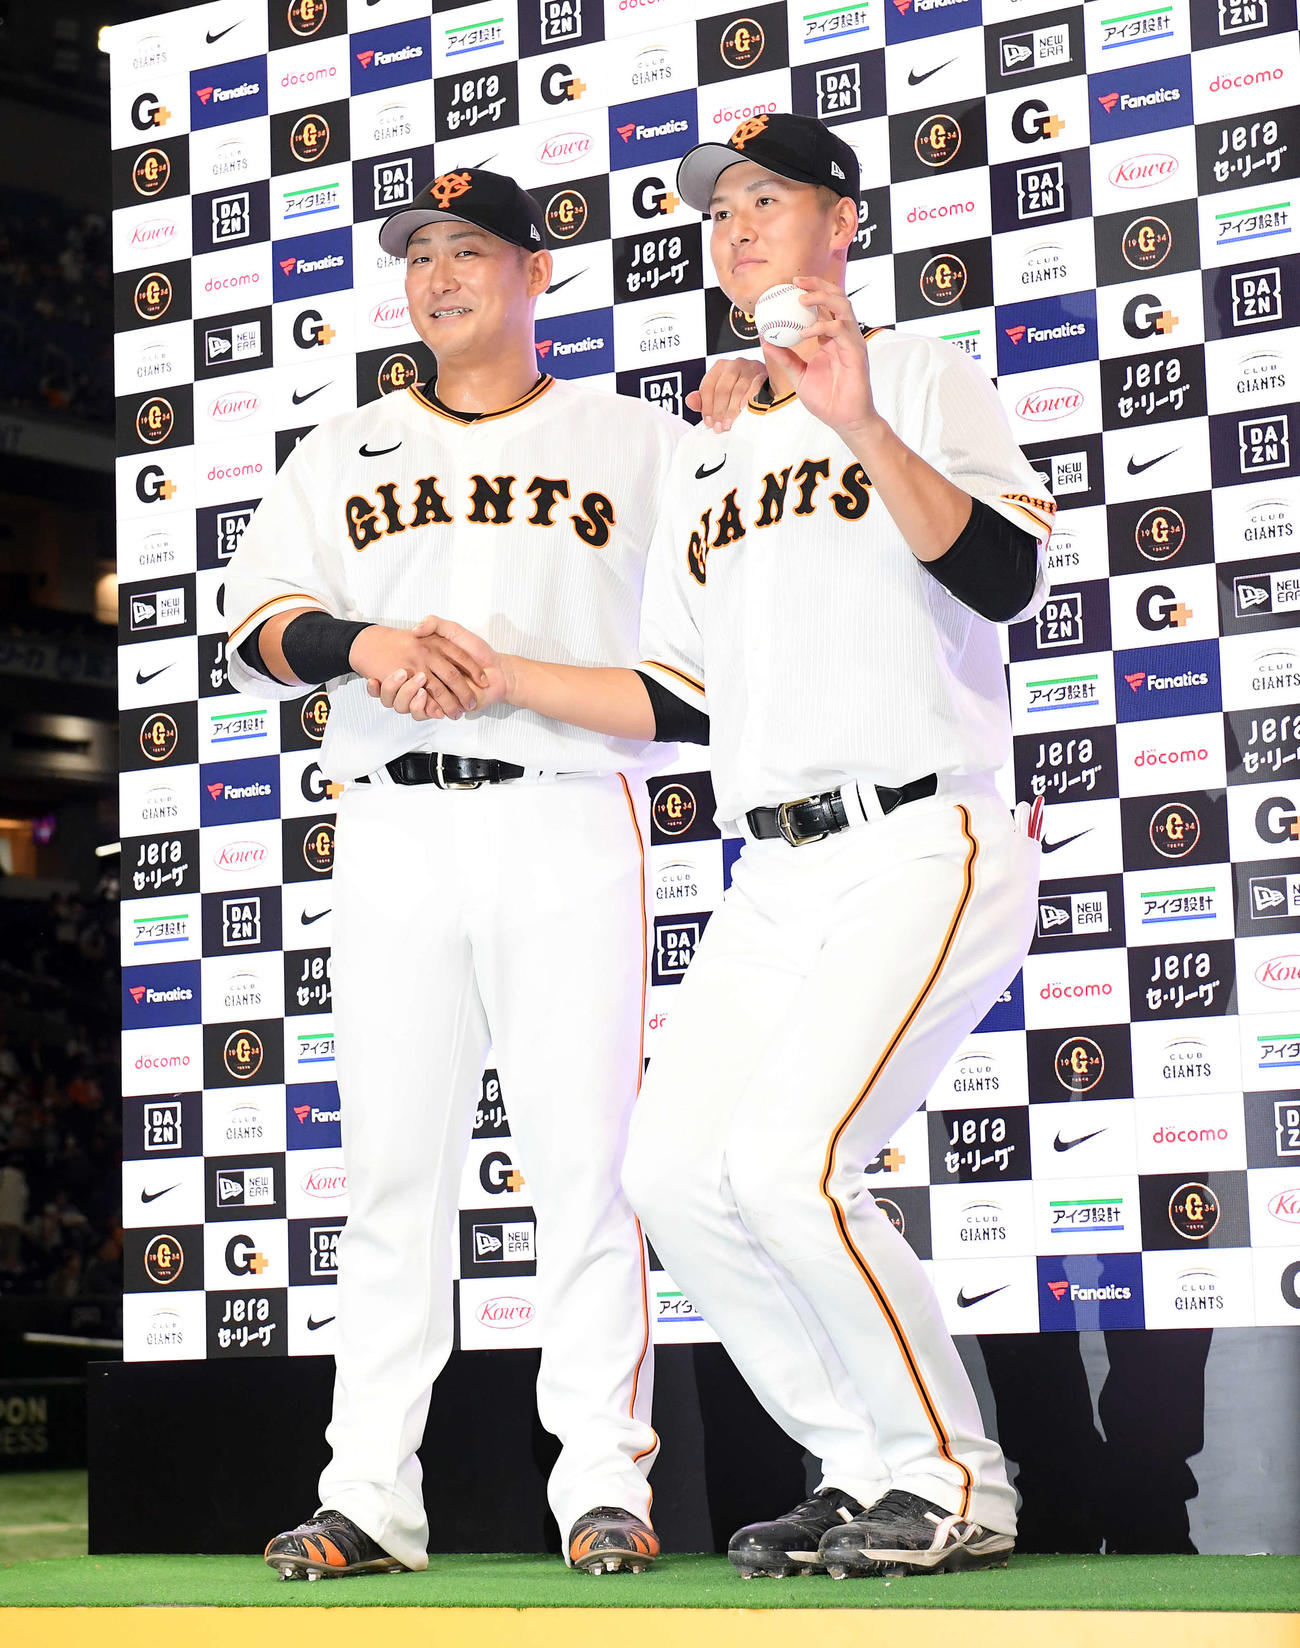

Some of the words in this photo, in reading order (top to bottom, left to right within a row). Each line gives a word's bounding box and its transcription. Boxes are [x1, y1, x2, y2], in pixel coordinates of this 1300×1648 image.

[550, 1, 572, 18] DA
[1230, 5, 1256, 25] ZN
[550, 17, 572, 35] ZN
[1039, 34, 1064, 47] NEW
[375, 46, 423, 66] Fanatics
[1039, 46, 1064, 58] ERA
[281, 67, 336, 87] docomo
[827, 74, 851, 94] DA
[1209, 69, 1283, 92] docomo
[213, 83, 259, 102] Fanatics
[827, 91, 850, 109] ZN
[1121, 88, 1180, 110] Fanatics
[636, 120, 688, 140] Fanatics
[540, 136, 591, 161] Kowa
[383, 168, 404, 185] DA
[1115, 157, 1175, 184] Kowa
[383, 181, 404, 201] ZN
[1028, 173, 1053, 193] DA
[1029, 190, 1053, 209] ZN
[221, 202, 241, 218] DA
[907, 201, 974, 222] docomo
[221, 217, 241, 234] ZN
[130, 225, 175, 245] Kowa
[297, 255, 344, 274] Fanatics
[205, 273, 259, 292] docomo
[1022, 266, 1067, 284] GIANTS
[1243, 278, 1270, 299] DA
[1244, 296, 1270, 316] ZN
[236, 331, 256, 340] NEW
[1027, 322, 1085, 343] Fanatics
[553, 337, 604, 356] Fanatics
[640, 335, 680, 352] GIANTS
[650, 382, 673, 398] DA
[1237, 375, 1285, 393] GIANTS
[213, 398, 257, 417] Kowa
[1022, 392, 1081, 414] Kowa
[1251, 426, 1278, 445] DA
[1252, 444, 1278, 463] ZN
[208, 464, 262, 480] docomo
[1057, 462, 1082, 474] NEW
[1058, 473, 1082, 485] ERA
[346, 475, 616, 552] GIANTS
[687, 457, 873, 586] GIANTS
[1244, 523, 1293, 542] GIANTS
[1047, 603, 1072, 620] DA
[1047, 621, 1072, 639] ZN
[1148, 671, 1208, 690] Fanatics
[1029, 685, 1096, 704] アイダ設計
[1134, 749, 1208, 766] docomo
[225, 783, 271, 799] Fanatics
[219, 847, 264, 864] Kowa
[656, 884, 698, 900] GIANTS
[232, 906, 251, 921] DA
[1077, 902, 1101, 912] NEW
[1145, 896, 1213, 915] アイダ設計
[1078, 912, 1102, 924] ERA
[232, 922, 251, 938] ZN
[667, 932, 690, 948] DA
[147, 987, 192, 1003] Fanatics
[1040, 983, 1112, 999] docomo
[135, 1056, 190, 1069] docomo
[1163, 1063, 1211, 1079] GIANTS
[954, 1077, 999, 1092] GIANTS
[153, 1110, 173, 1126] DA
[312, 1108, 341, 1123] Fana
[153, 1127, 173, 1142] ZN
[1153, 1127, 1227, 1143] docomo
[250, 1177, 268, 1186] NEW
[1052, 1208, 1121, 1224] アイダ設計
[508, 1232, 529, 1241] NEW
[960, 1226, 1006, 1241] GIANTS
[1070, 1284, 1131, 1300] Fanatics
[1175, 1296, 1223, 1310] GIANTS
[481, 1304, 532, 1321] Kowa
